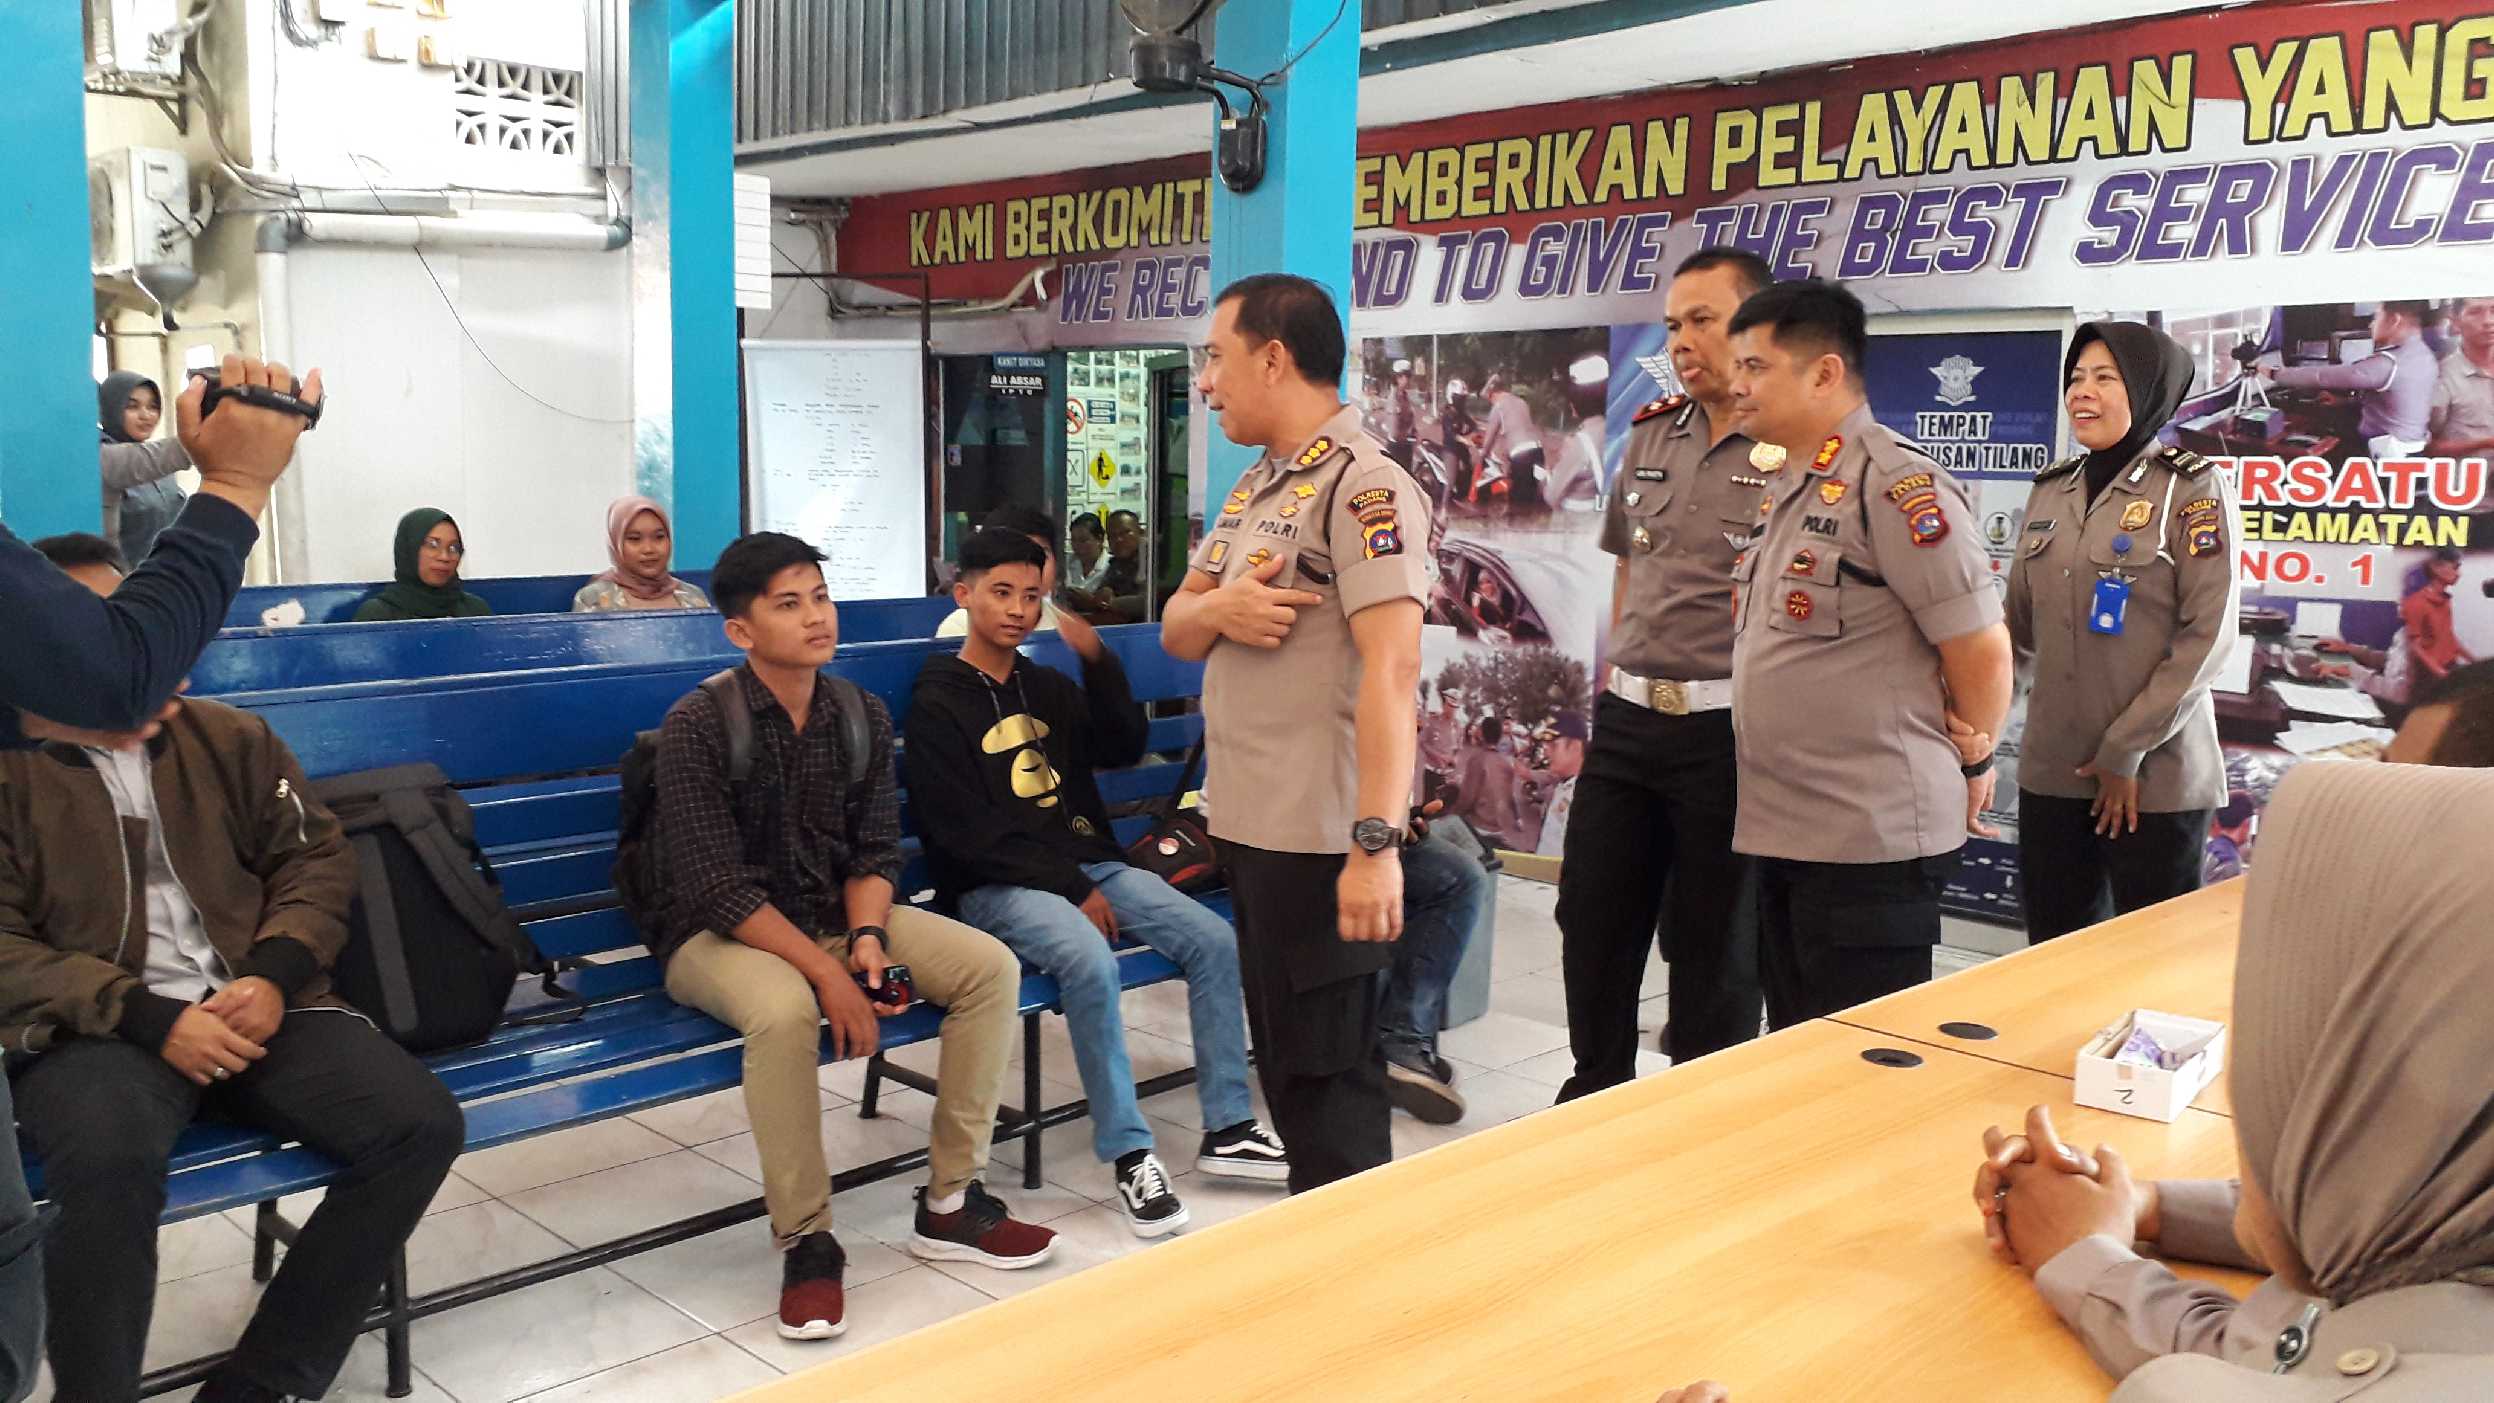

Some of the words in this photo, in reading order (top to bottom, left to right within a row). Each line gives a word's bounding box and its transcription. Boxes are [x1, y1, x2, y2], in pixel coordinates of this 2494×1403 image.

[909, 202, 995, 268] KAMI
[1353, 115, 1692, 230] EMBERIKAN
[1710, 52, 2194, 192] PELAYANAN
[2231, 16, 2494, 144] YANG
[1058, 261, 1121, 325] WE
[1433, 227, 1510, 306] TO
[1516, 211, 1672, 300] GIVE
[1692, 197, 1832, 280] THE
[1837, 177, 2069, 280] BEST
[2072, 139, 2494, 268] SERVICE
[990, 374, 1007, 385] ALI
[1916, 412, 1992, 440] TEMPAT
[1919, 443, 1979, 471] USAN
[1981, 443, 2049, 472] TILANG
[1256, 520, 1298, 540] POLRI
[1801, 515, 1840, 537] POLRI
[2241, 510, 2471, 547] ELAMATAN
[2240, 550, 2327, 586] NO.
[2350, 552, 2376, 587] 1
